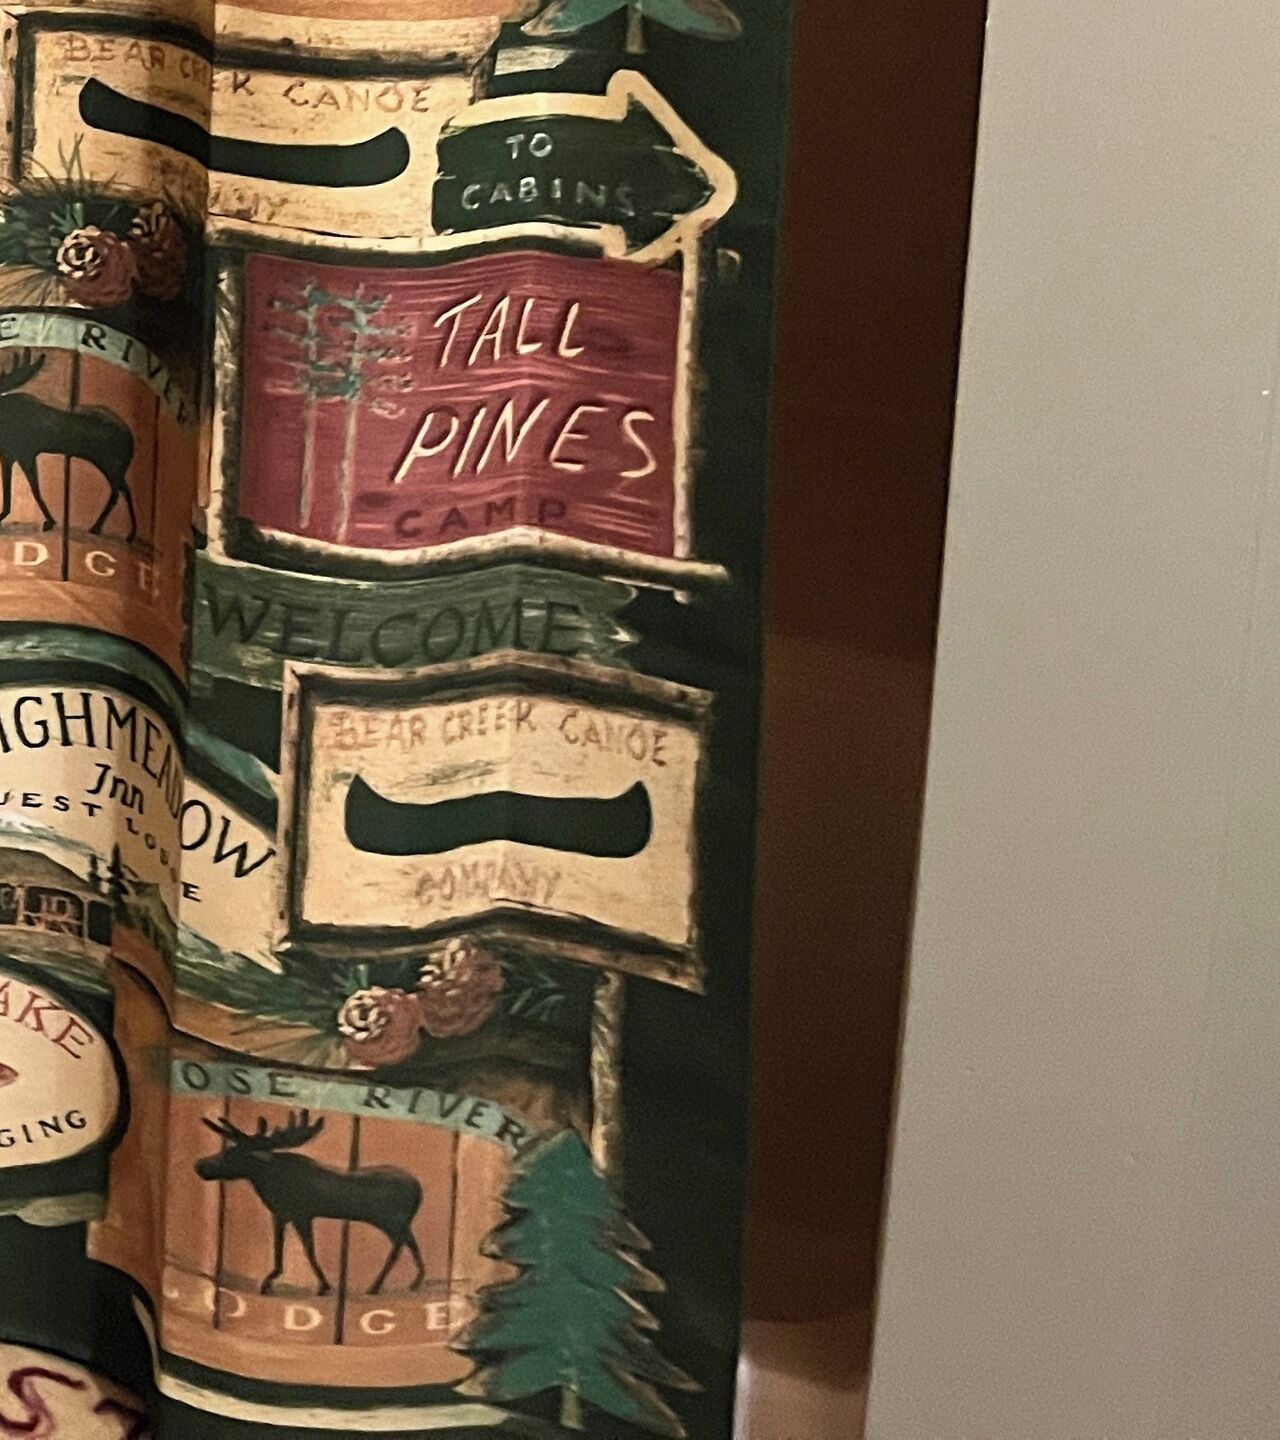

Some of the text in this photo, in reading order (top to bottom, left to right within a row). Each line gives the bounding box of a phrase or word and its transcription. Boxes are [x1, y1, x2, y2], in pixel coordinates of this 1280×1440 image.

[60, 32, 167, 71] BEAR
[282, 79, 433, 114] CANOE
[504, 132, 554, 158] TO
[461, 175, 636, 217] CABINS
[434, 293, 586, 368] TALL
[391, 397, 657, 485] PINES
[392, 497, 568, 539] CAMP
[203, 582, 582, 666] WELCOME
[330, 701, 669, 768] BEAR CREEK CANOE
[86, 762, 144, 815] Inn
[362, 1083, 540, 1151] RIVER
